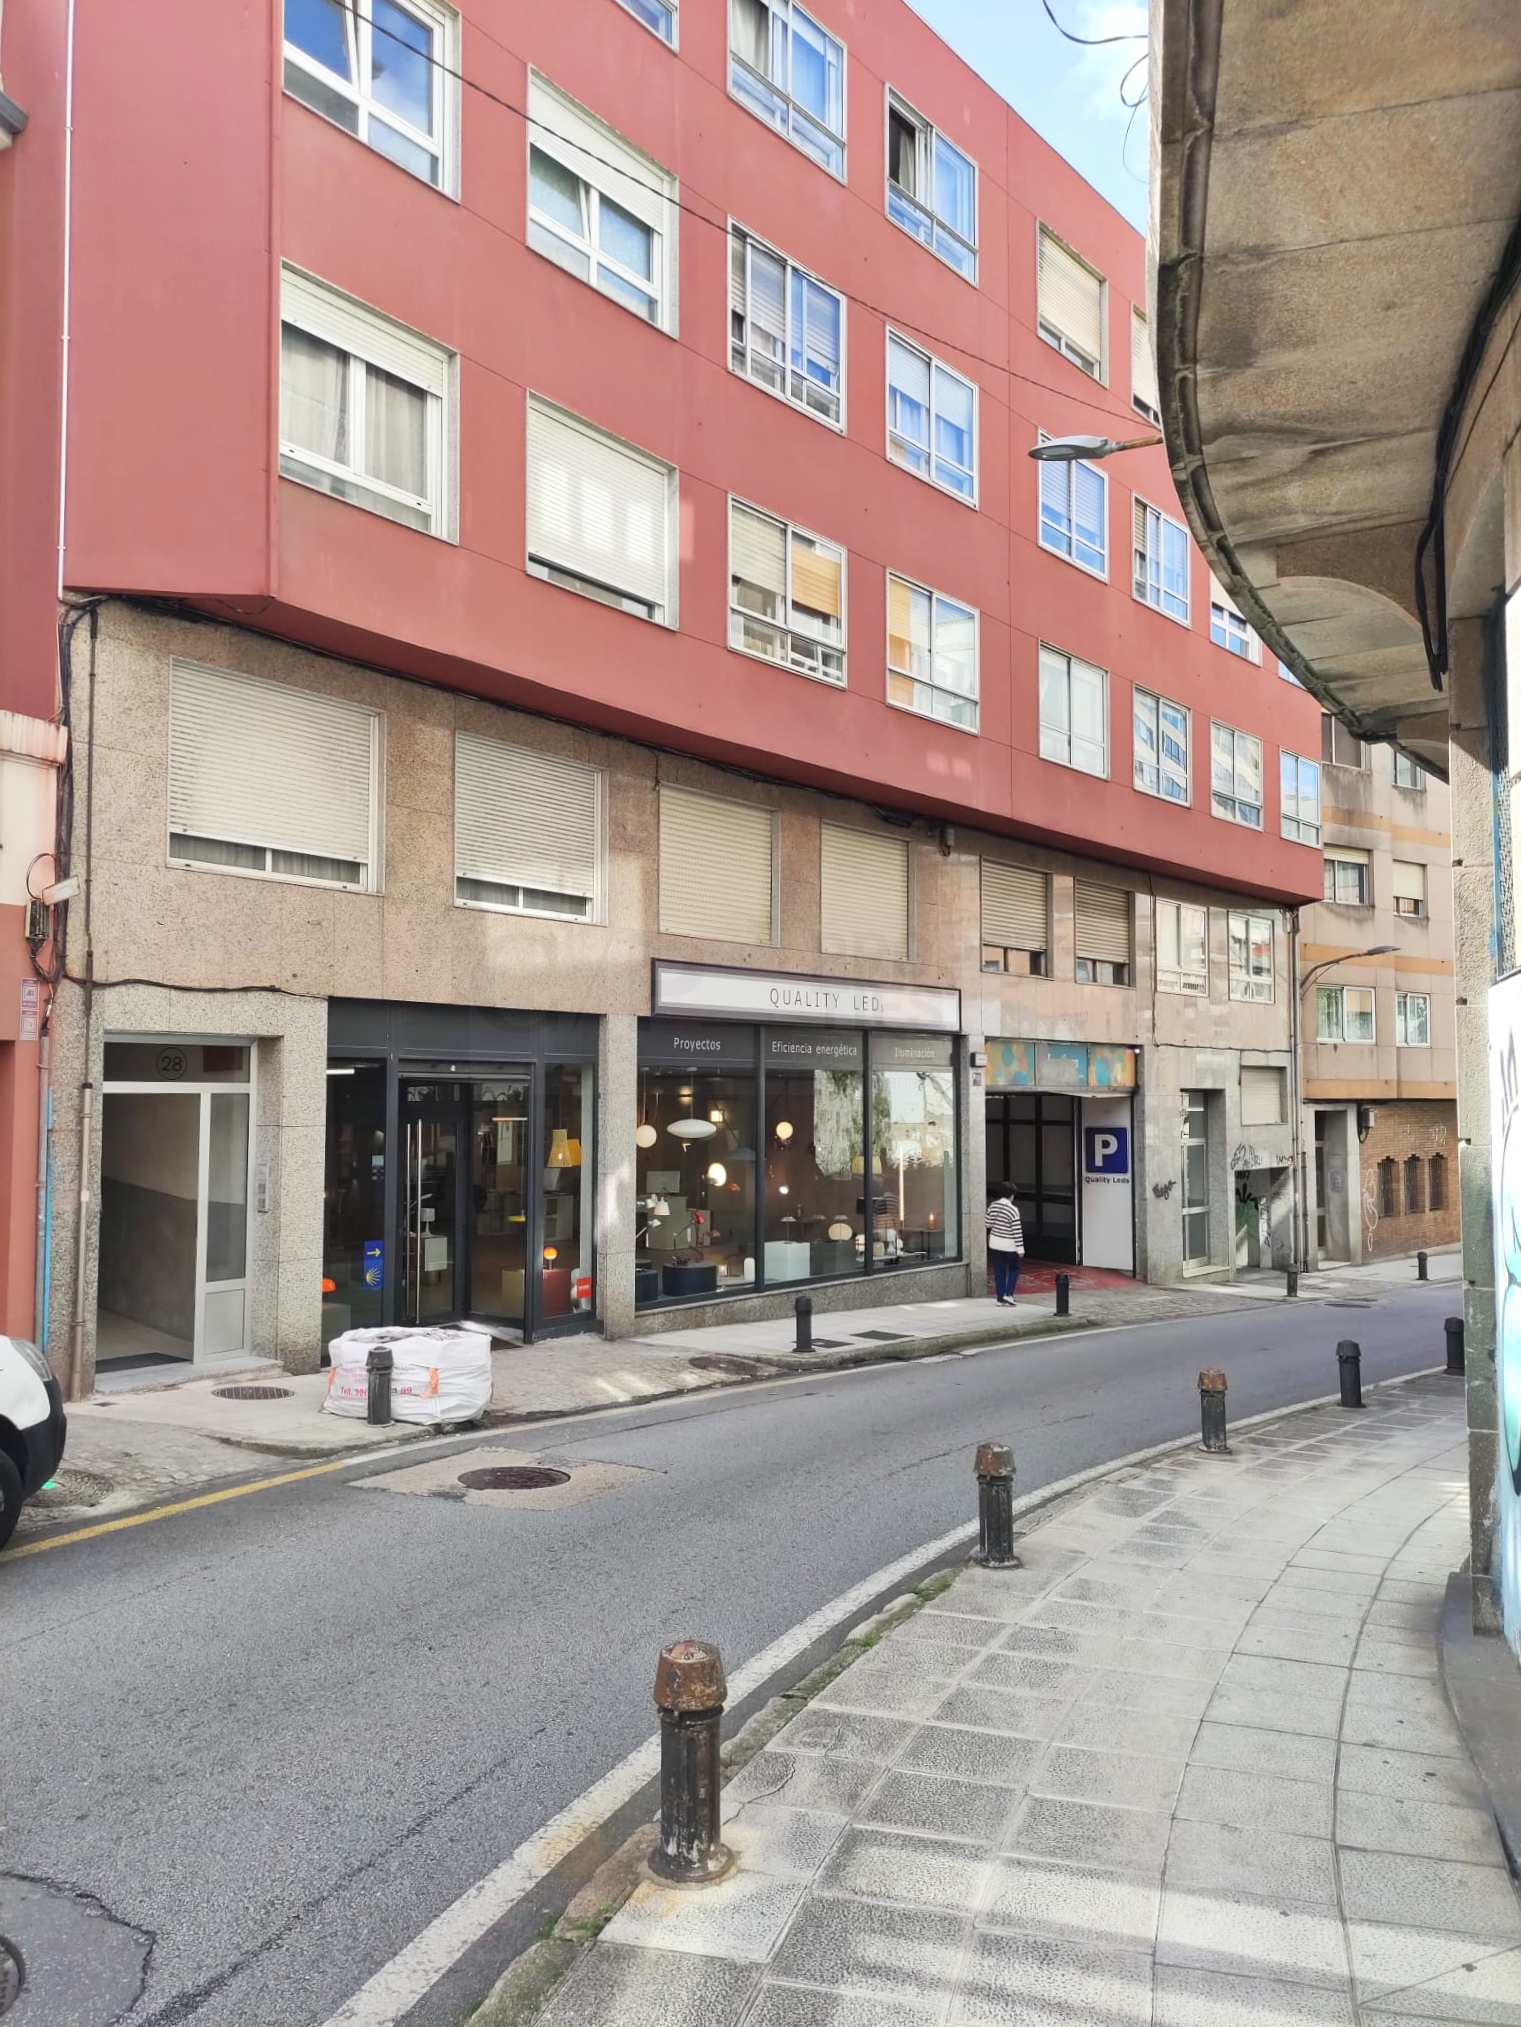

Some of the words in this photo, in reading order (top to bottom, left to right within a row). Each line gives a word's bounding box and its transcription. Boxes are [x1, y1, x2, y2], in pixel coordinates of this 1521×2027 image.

[769, 987, 840, 1009] QUALITY
[673, 1037, 721, 1052] Proyectos
[771, 1040, 812, 1054] Eficiencia
[815, 1043, 858, 1059] energética
[894, 1046, 935, 1059] Iluminación
[161, 1056, 183, 1072] 28
[1094, 1133, 1118, 1167] P
[1084, 1176, 1111, 1185] Quality
[1112, 1176, 1130, 1184] Leds
